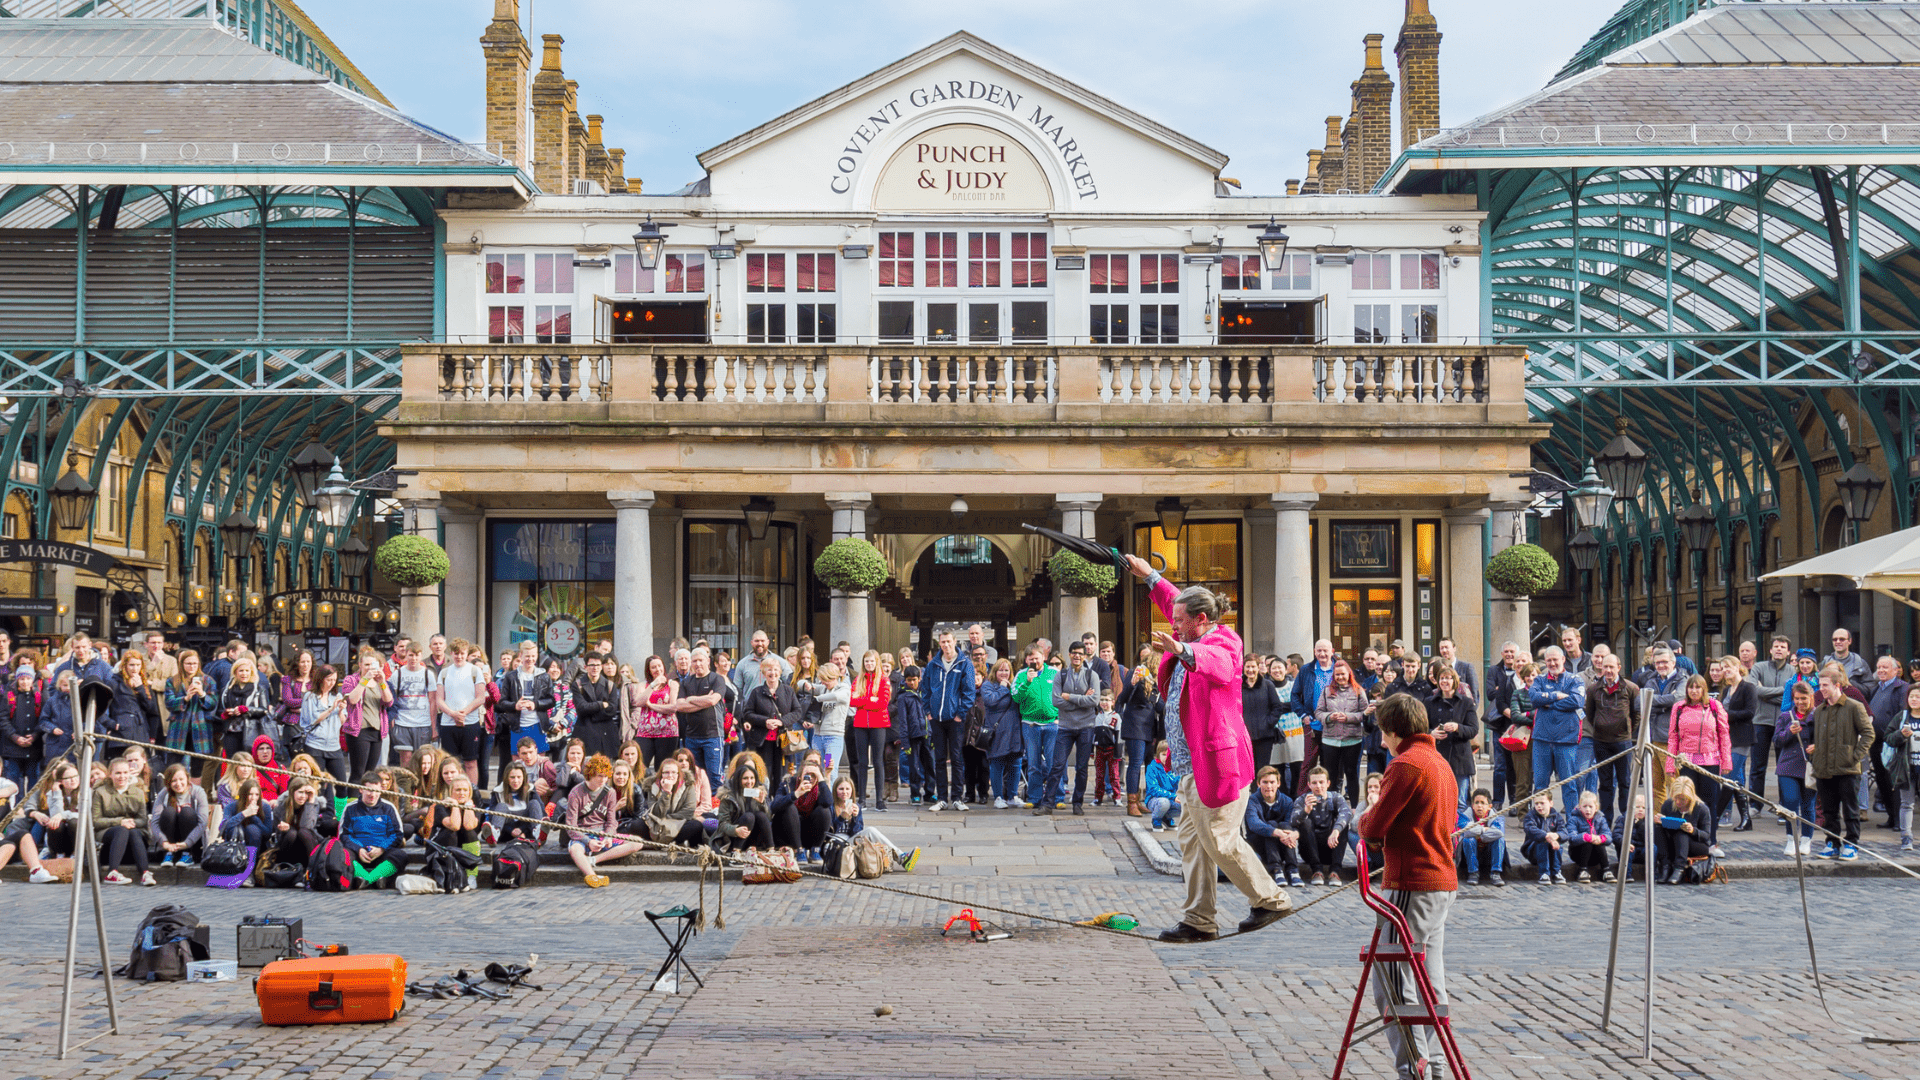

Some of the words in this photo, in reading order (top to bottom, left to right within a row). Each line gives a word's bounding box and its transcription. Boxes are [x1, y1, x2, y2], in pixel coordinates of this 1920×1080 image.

[830, 99, 903, 195] COVENT
[909, 80, 1023, 112] GARDEN
[1027, 105, 1099, 201] MARKET
[916, 143, 1007, 164] PUNCH
[917, 169, 938, 190] &
[944, 169, 1008, 195] JUDY
[952, 192, 987, 201] BALCONY
[989, 192, 1006, 201] BAR
[19, 544, 94, 565] MARKET
[284, 591, 313, 602] PPLE
[320, 591, 373, 606] MARKET
[76, 618, 93, 627] LINKS
[550, 627, 559, 641] 3
[566, 627, 575, 641] 2
